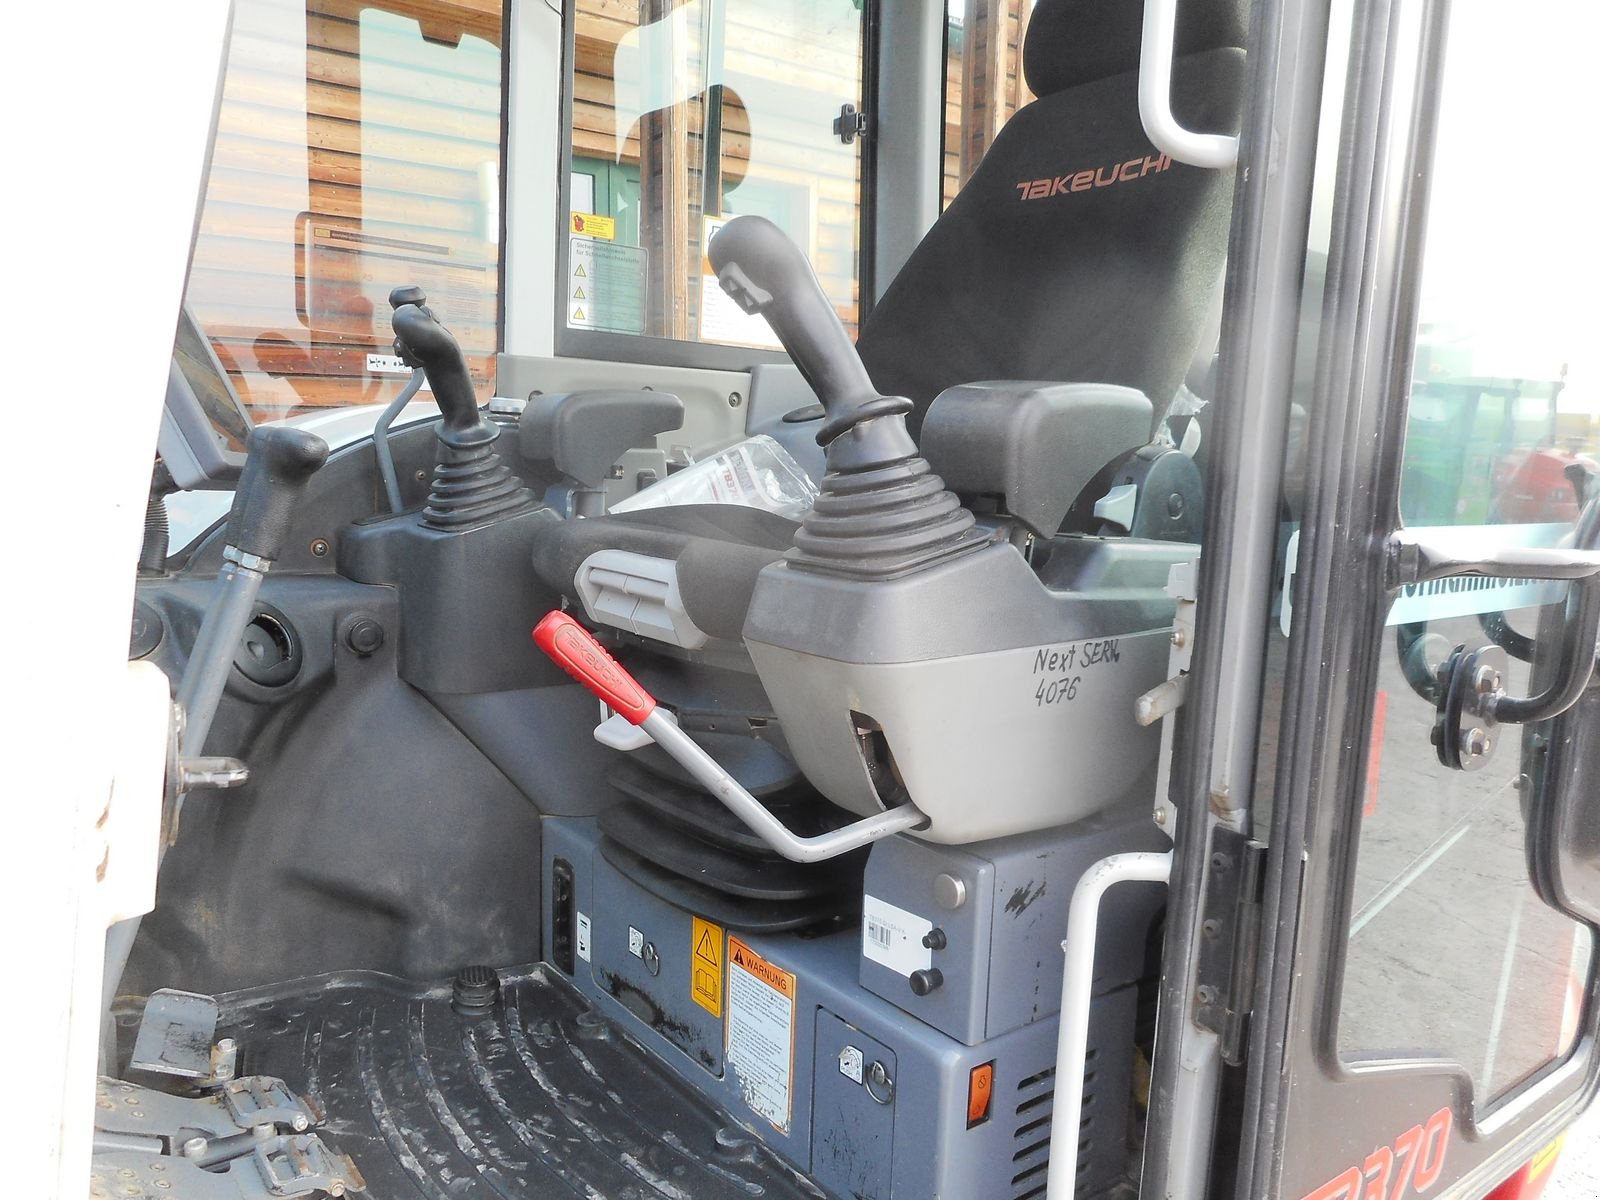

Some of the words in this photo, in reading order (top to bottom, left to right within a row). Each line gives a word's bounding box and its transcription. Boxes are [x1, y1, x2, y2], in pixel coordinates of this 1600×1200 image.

[1033, 644, 1076, 674] Next
[1035, 676, 1081, 707] 4076
[746, 955, 788, 991] WARNUNG
